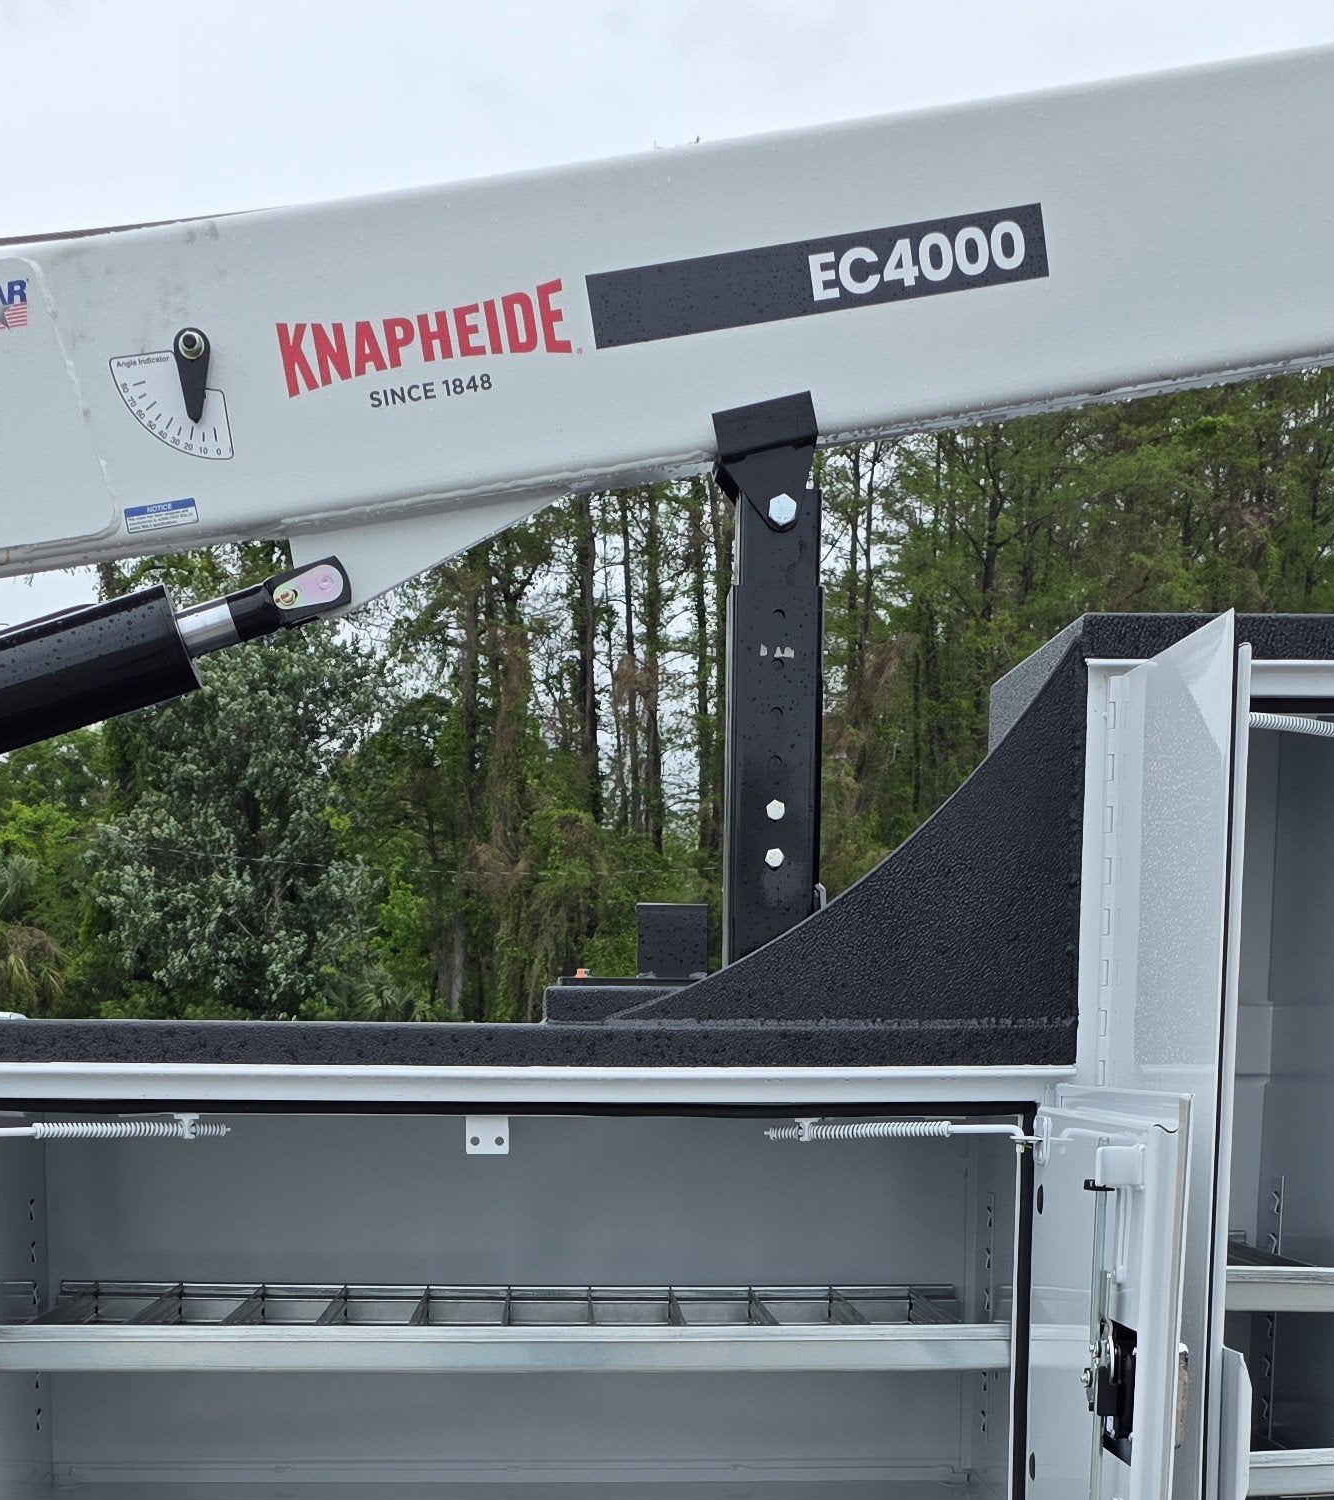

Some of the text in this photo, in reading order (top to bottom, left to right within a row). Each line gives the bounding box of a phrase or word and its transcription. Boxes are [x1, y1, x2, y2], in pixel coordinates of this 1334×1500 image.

[808, 220, 1026, 302] EC4000
[275, 278, 573, 399] KNAPHEIDE
[116, 354, 170, 369] Angle Indicator
[120, 382, 130, 394] 80
[369, 373, 493, 409] SINCE 1848
[127, 397, 137, 408] 70
[135, 408, 145, 420] 60
[147, 420, 157, 431] 50
[157, 429, 167, 440] 40
[170, 436, 181, 446] 30
[183, 442, 194, 452] 20
[199, 446, 208, 455] 10
[216, 447, 222, 456] 0
[146, 502, 173, 513] NOTICE
